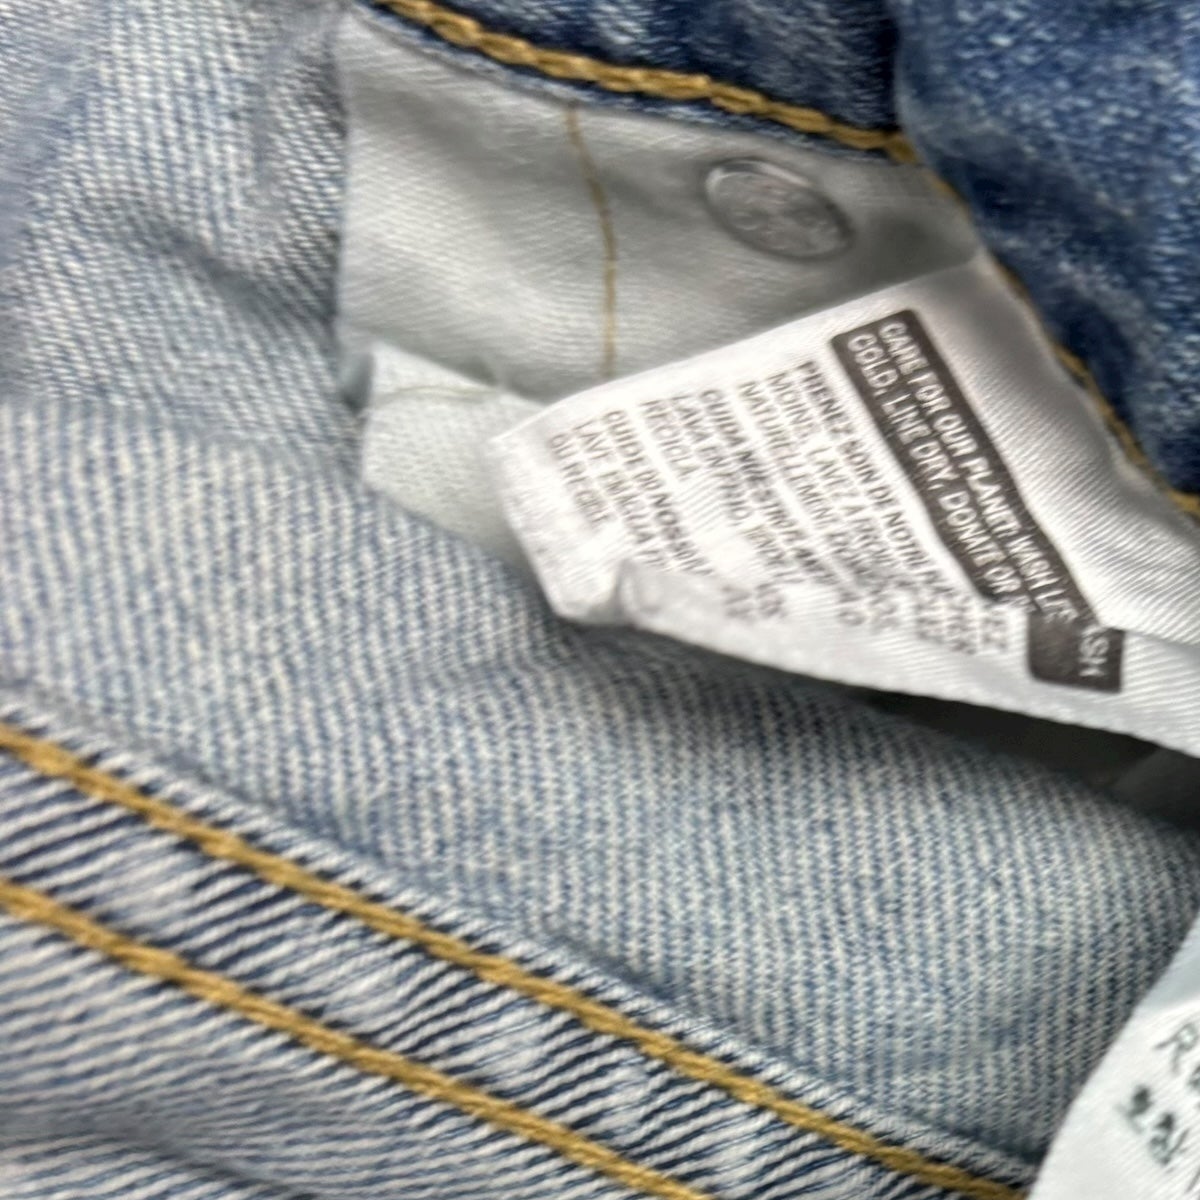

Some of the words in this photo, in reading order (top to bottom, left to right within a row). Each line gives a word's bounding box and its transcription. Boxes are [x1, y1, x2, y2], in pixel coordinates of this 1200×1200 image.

[879, 322, 928, 375] CARE
[908, 373, 951, 416] FOR
[933, 413, 978, 457] OUR
[1007, 535, 1059, 591] WASH
[882, 395, 931, 444] LINE
[910, 441, 958, 490] DRY,
[938, 491, 1006, 568] DONATE
[984, 565, 1021, 594] OR
